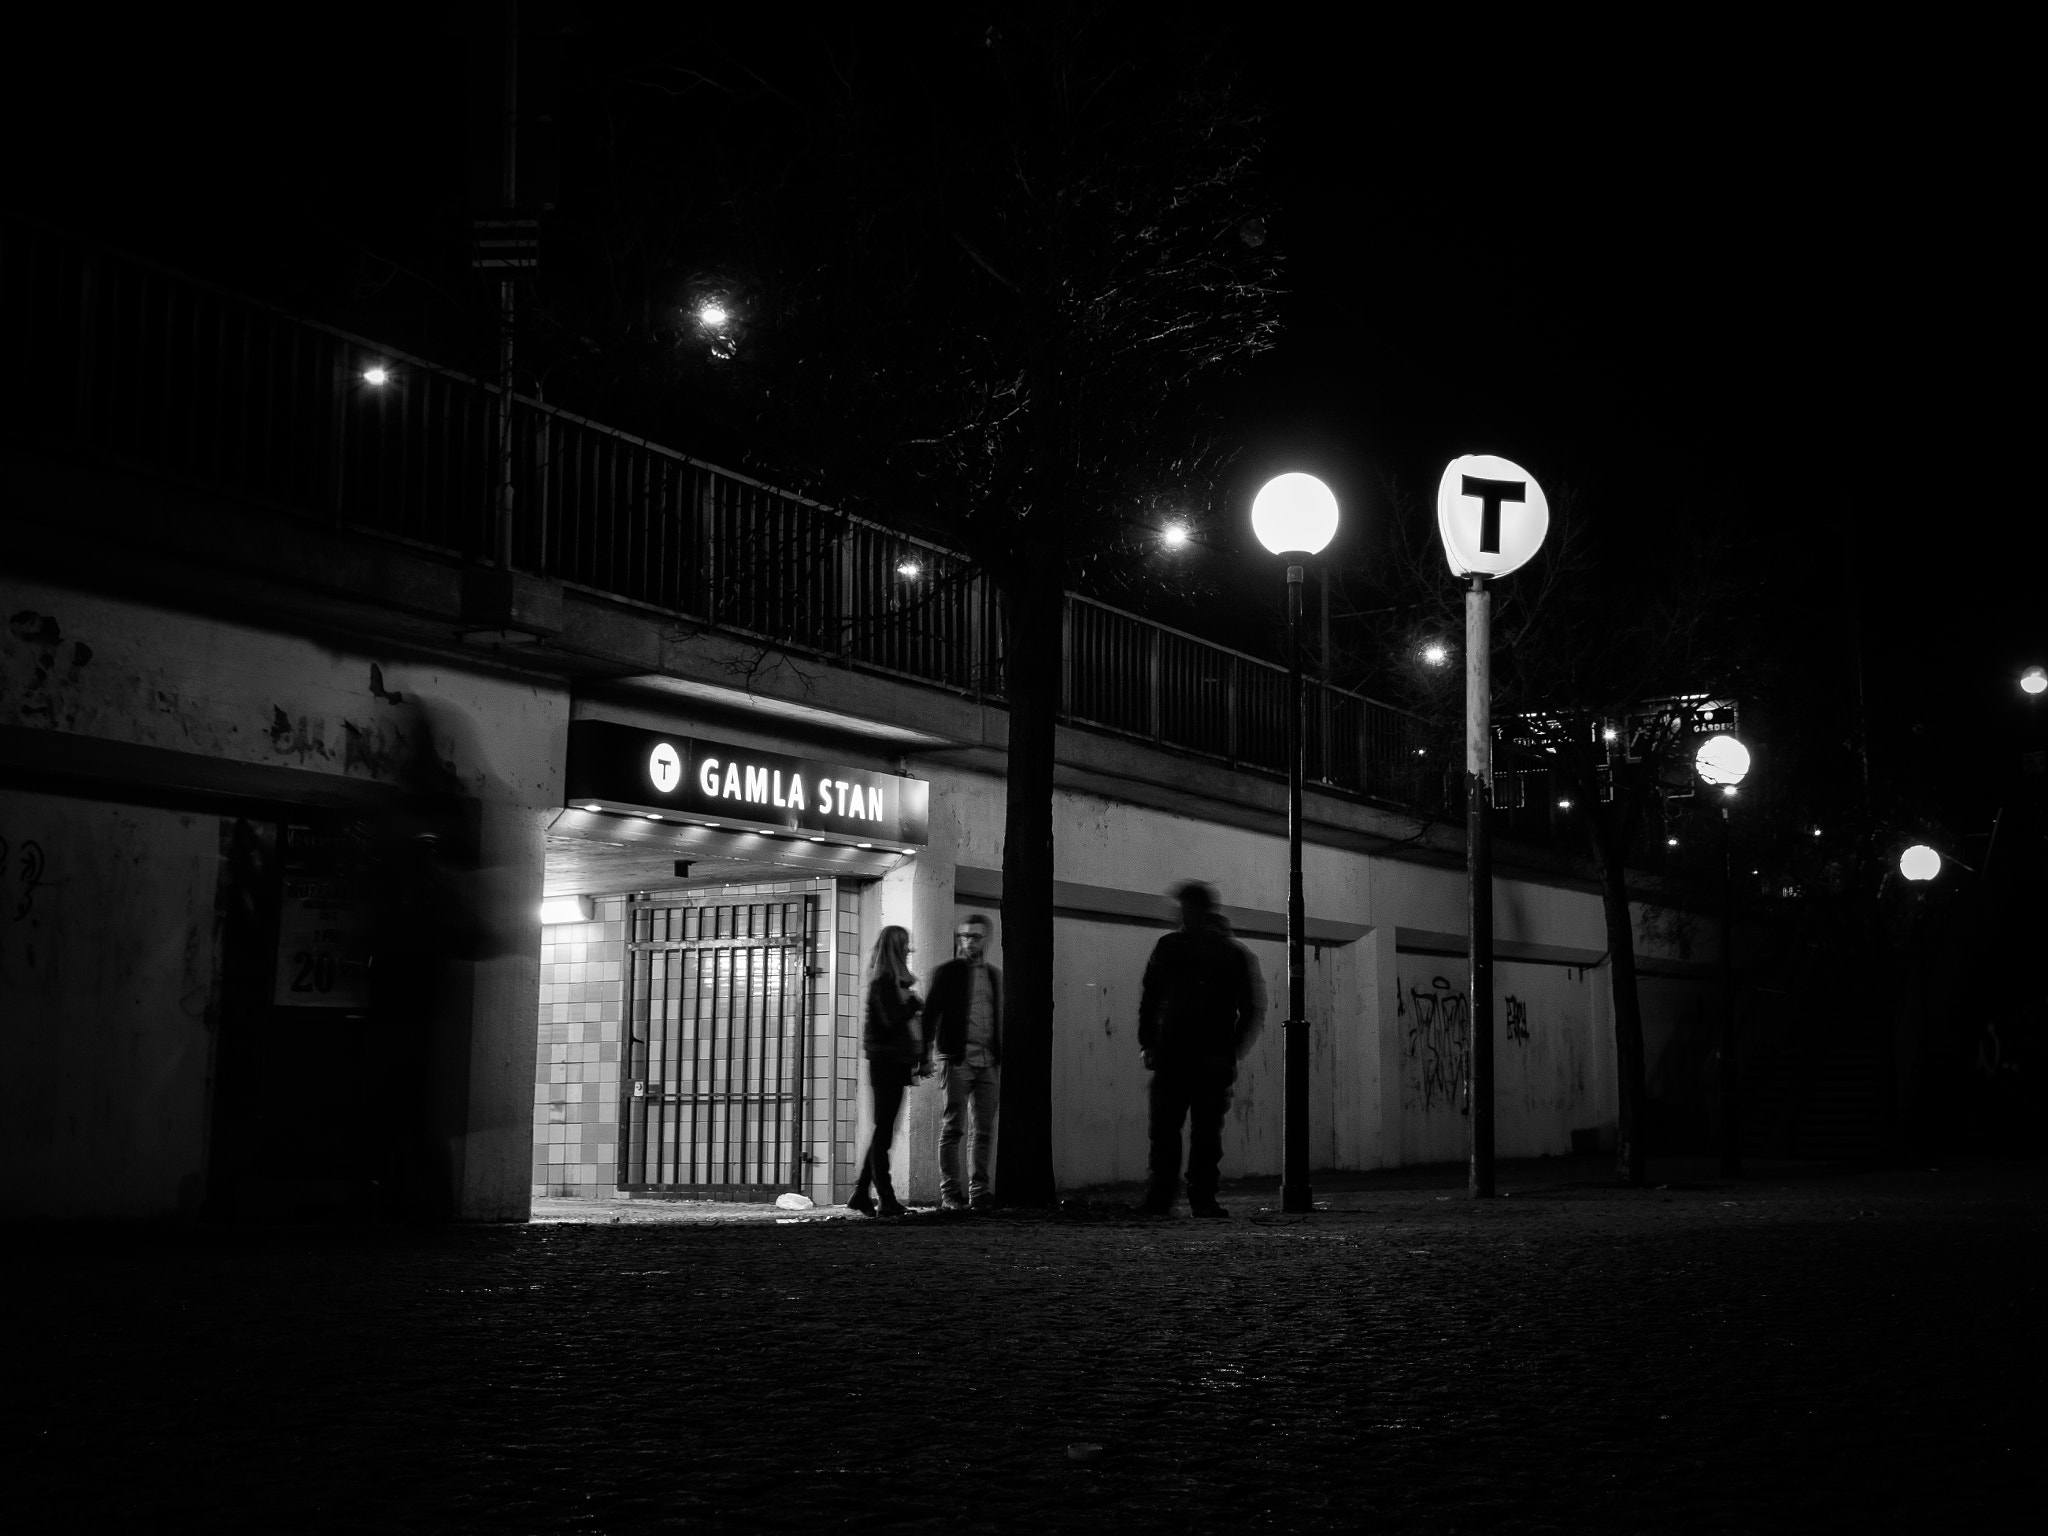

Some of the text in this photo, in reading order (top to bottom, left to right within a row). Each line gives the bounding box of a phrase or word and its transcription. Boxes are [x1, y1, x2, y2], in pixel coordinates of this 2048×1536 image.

[1462, 474, 1527, 554] T
[700, 758, 805, 810] GAMLA
[819, 778, 883, 821] STAN
[291, 951, 335, 993] 20
